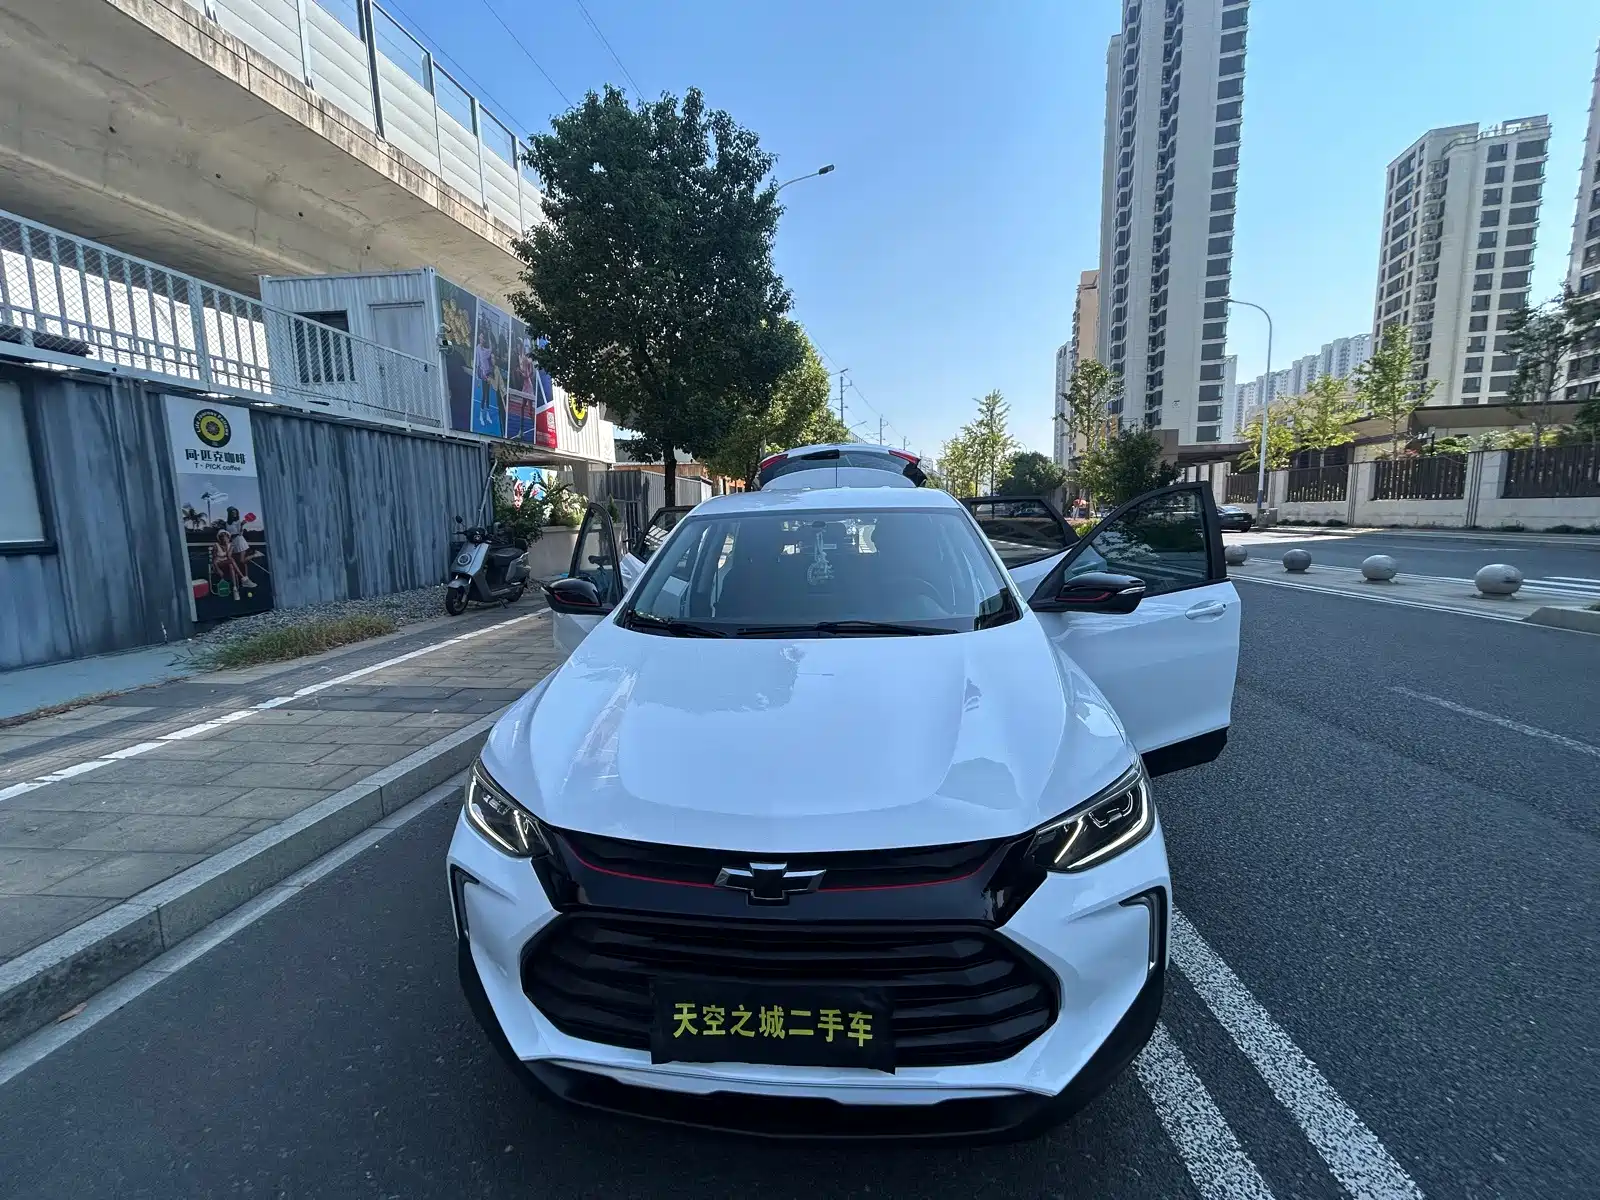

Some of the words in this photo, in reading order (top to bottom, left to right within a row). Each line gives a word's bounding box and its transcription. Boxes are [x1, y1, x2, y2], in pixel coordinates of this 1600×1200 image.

[672, 1002, 874, 1047] 天空之城二手车
